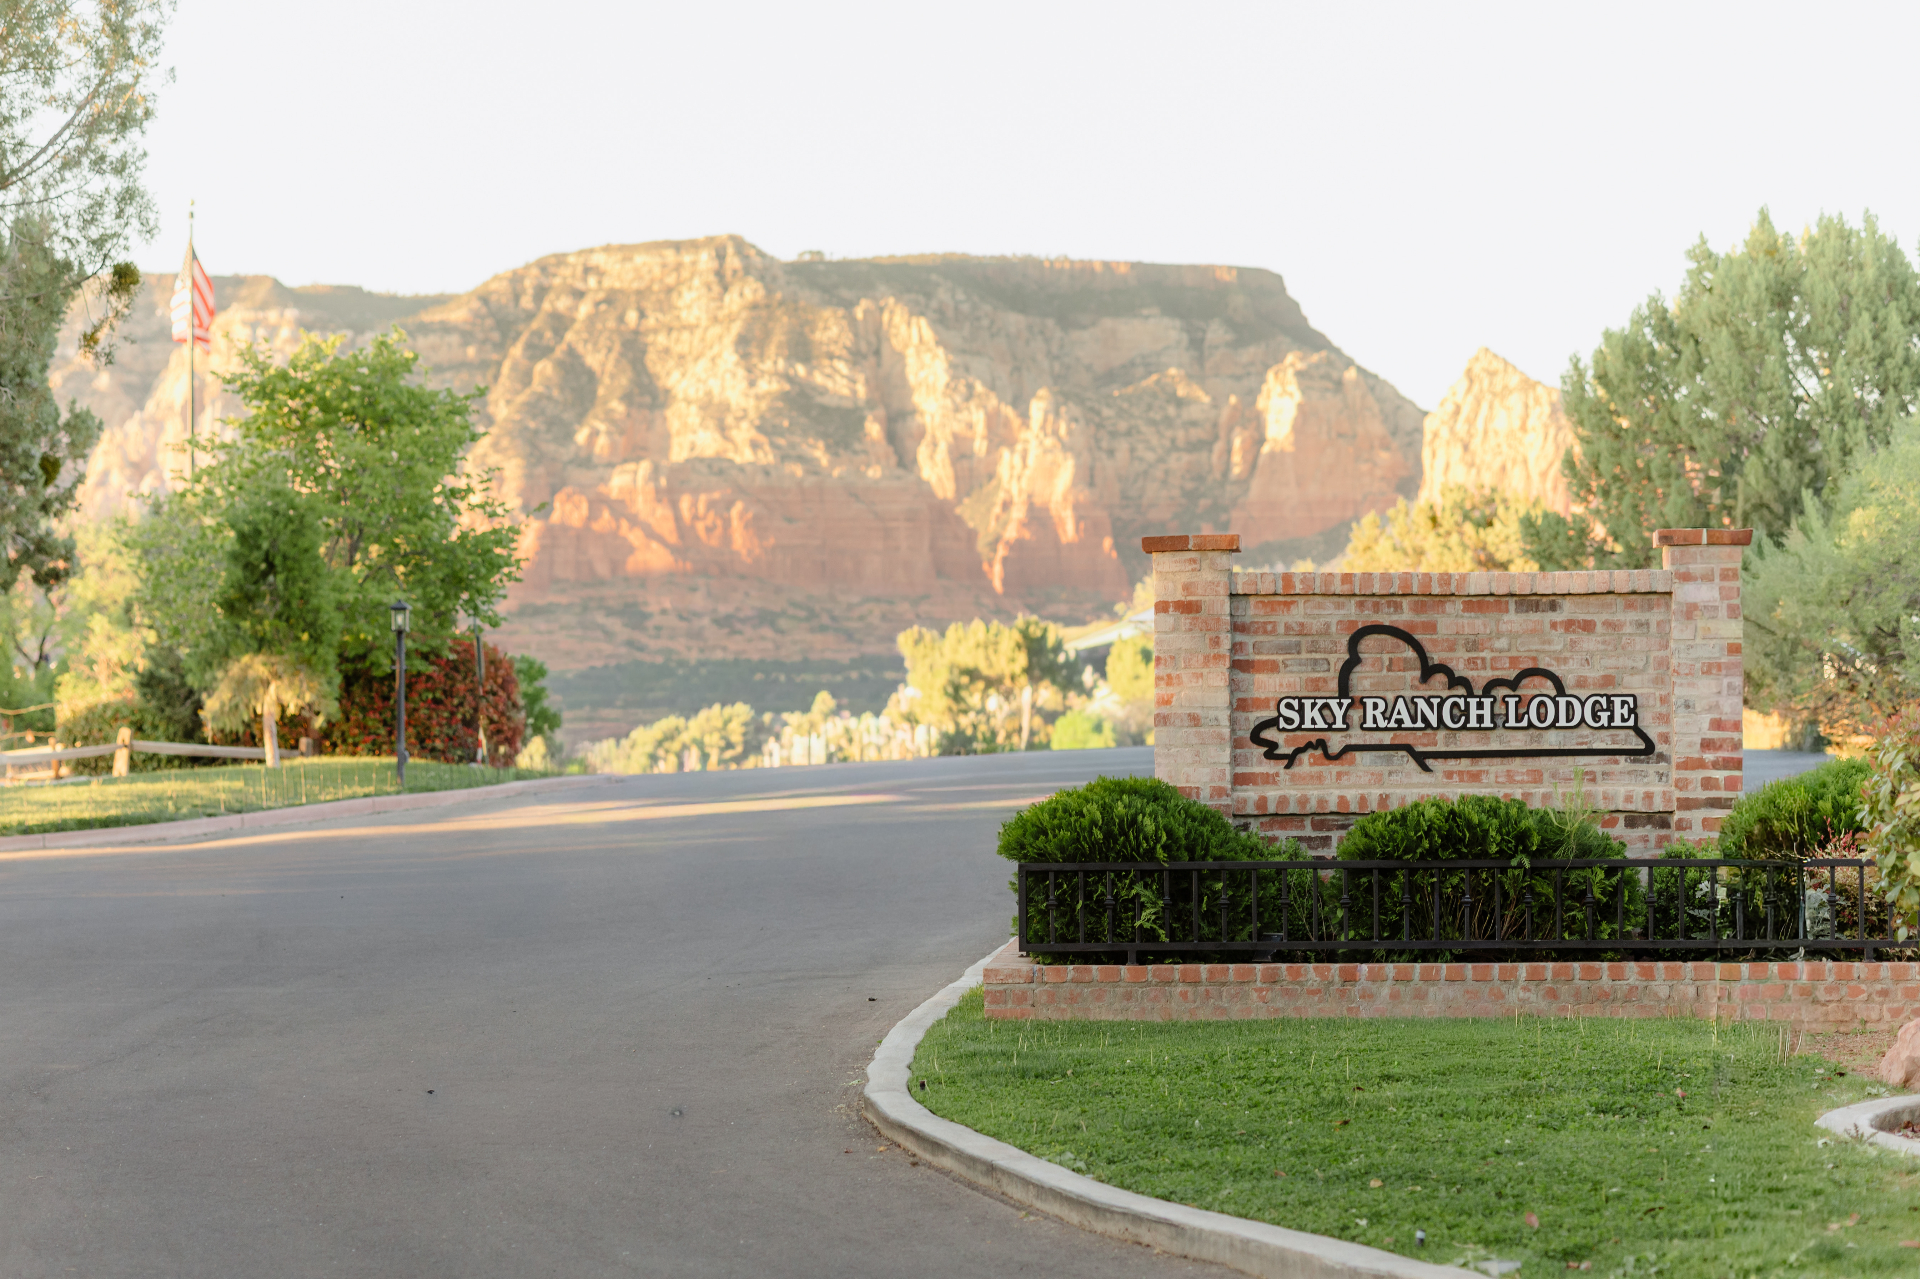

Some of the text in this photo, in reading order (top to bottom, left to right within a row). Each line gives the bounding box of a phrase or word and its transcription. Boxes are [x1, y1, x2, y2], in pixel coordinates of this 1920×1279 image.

[1278, 696, 1636, 729] SKY RANCH LODGE
